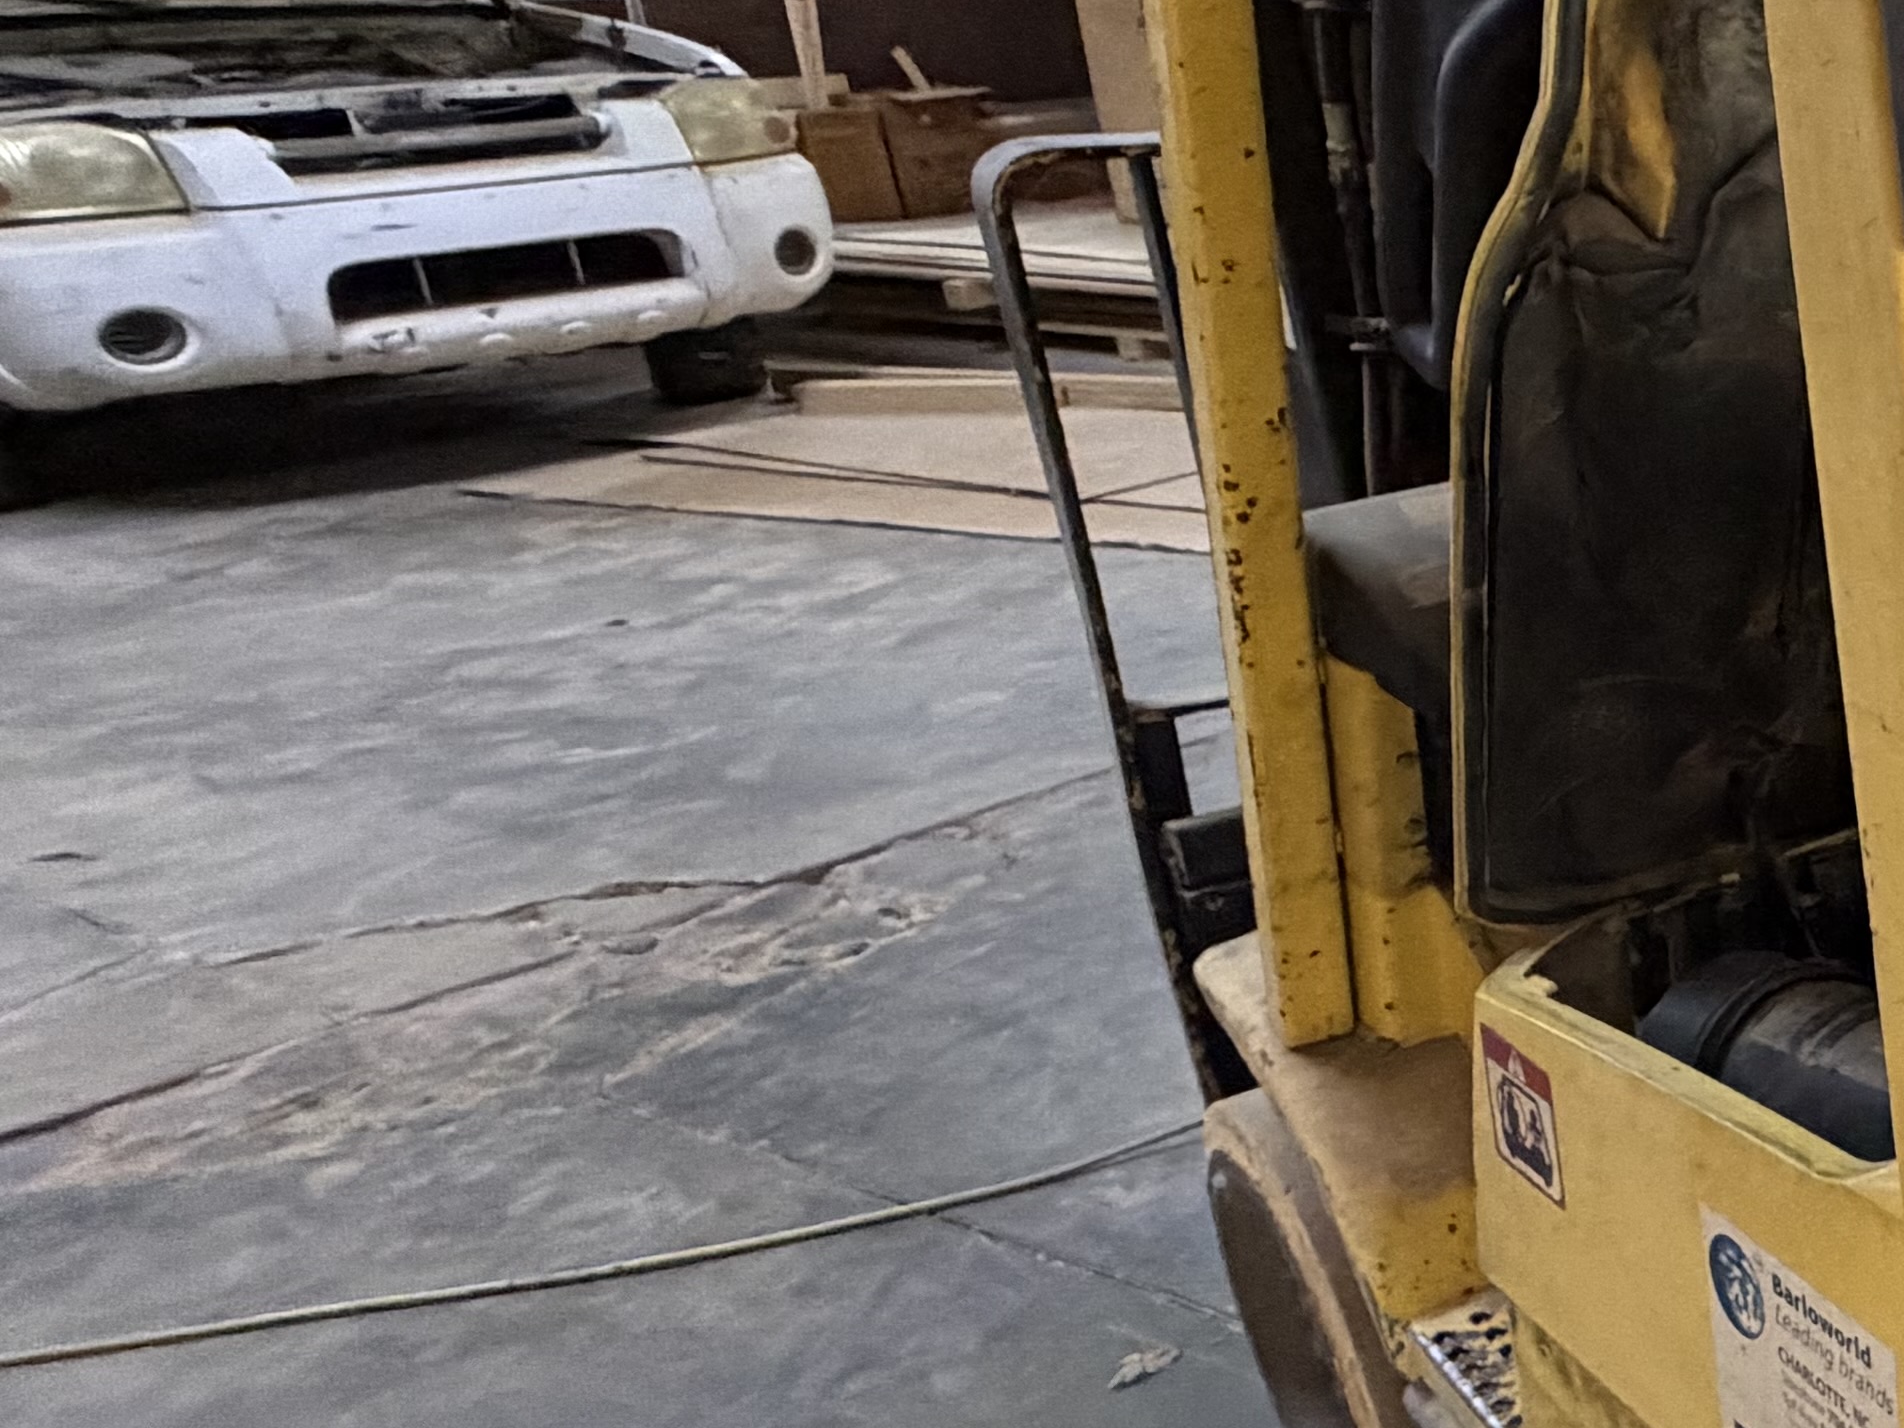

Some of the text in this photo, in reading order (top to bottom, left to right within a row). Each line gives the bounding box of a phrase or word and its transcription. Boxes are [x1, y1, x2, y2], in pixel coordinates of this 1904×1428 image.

[1771, 1272, 1872, 1370] Barloworld
[1775, 1303, 1834, 1371] Leading
[1838, 1352, 1894, 1415] brands
